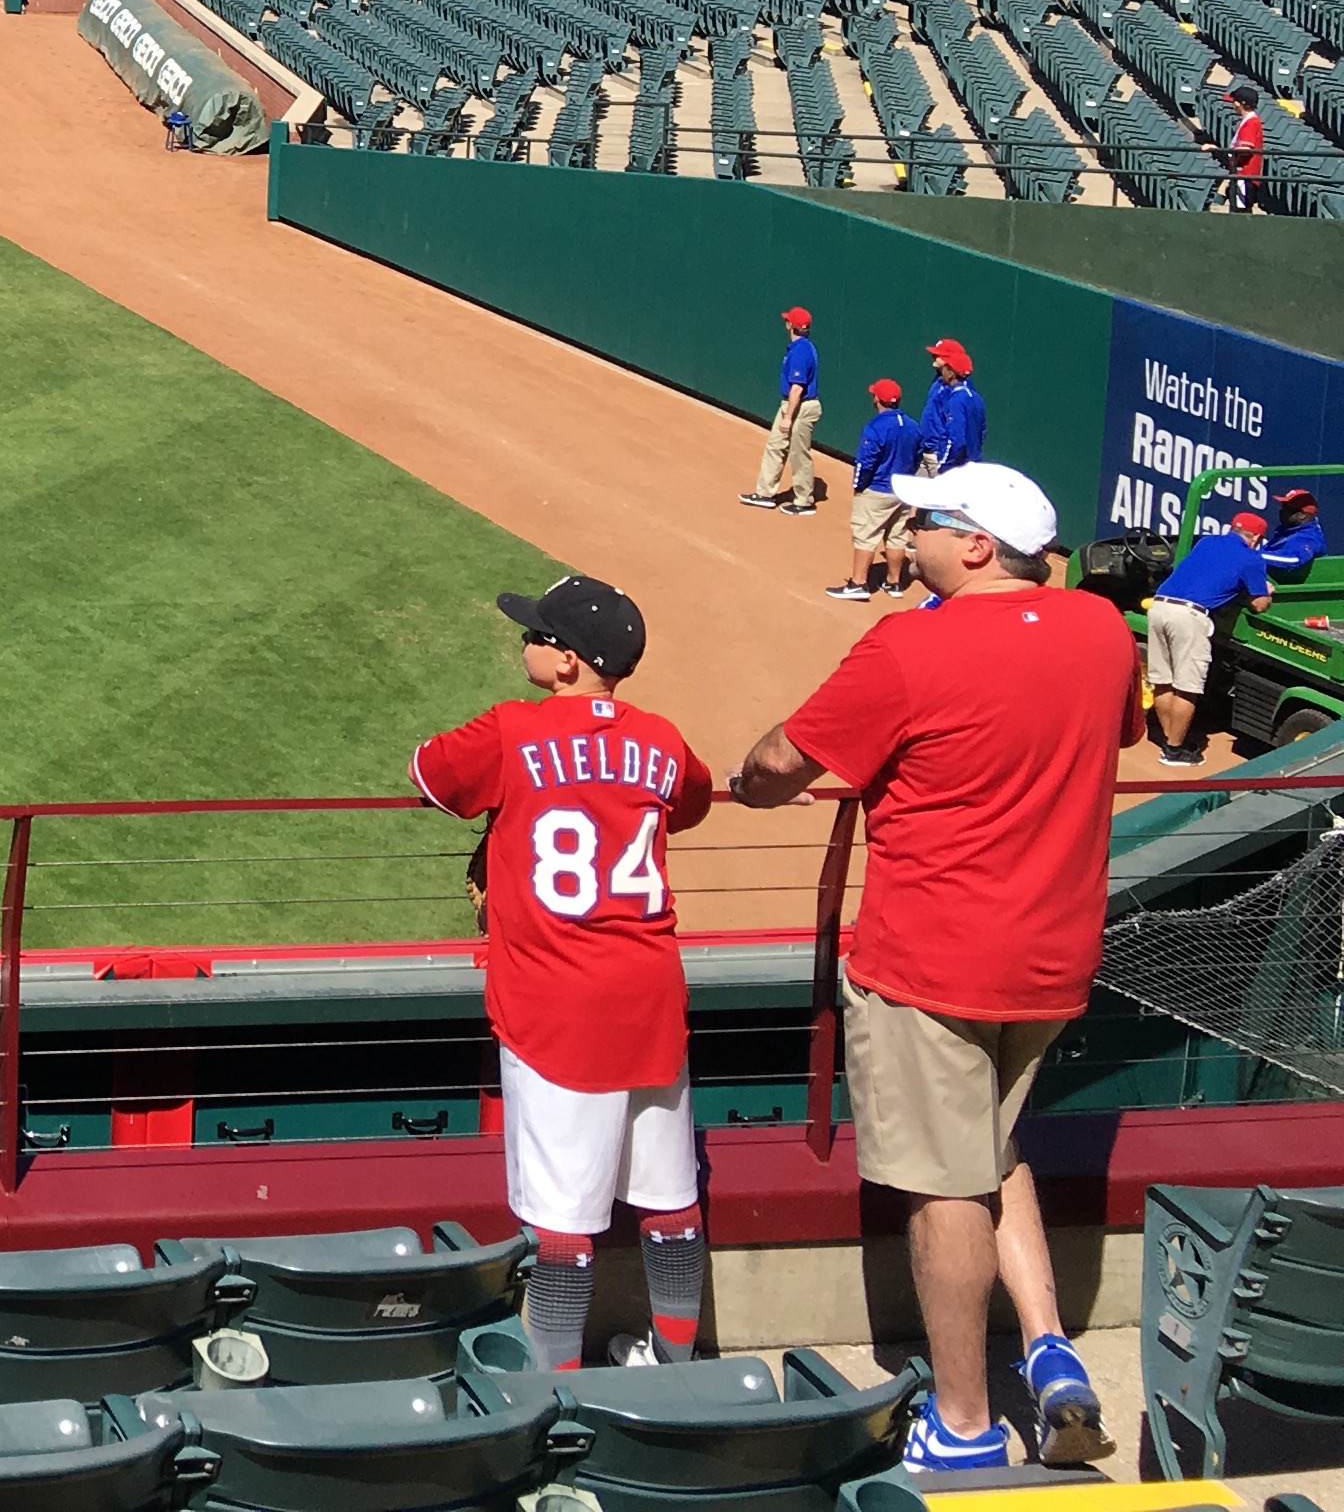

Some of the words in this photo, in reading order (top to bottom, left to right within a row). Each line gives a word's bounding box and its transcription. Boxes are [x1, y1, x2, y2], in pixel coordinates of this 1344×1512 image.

[110, 9, 142, 48] GEICO
[133, 32, 165, 78] GEICO
[157, 58, 193, 106] GEICO
[1145, 358, 1219, 422] Watch
[1224, 386, 1263, 437] the
[1111, 473, 1153, 529] All
[1256, 630, 1288, 647] JOHN
[1289, 642, 1327, 663] DEERE
[518, 734, 679, 801] FIELDER
[529, 805, 669, 921] 84
